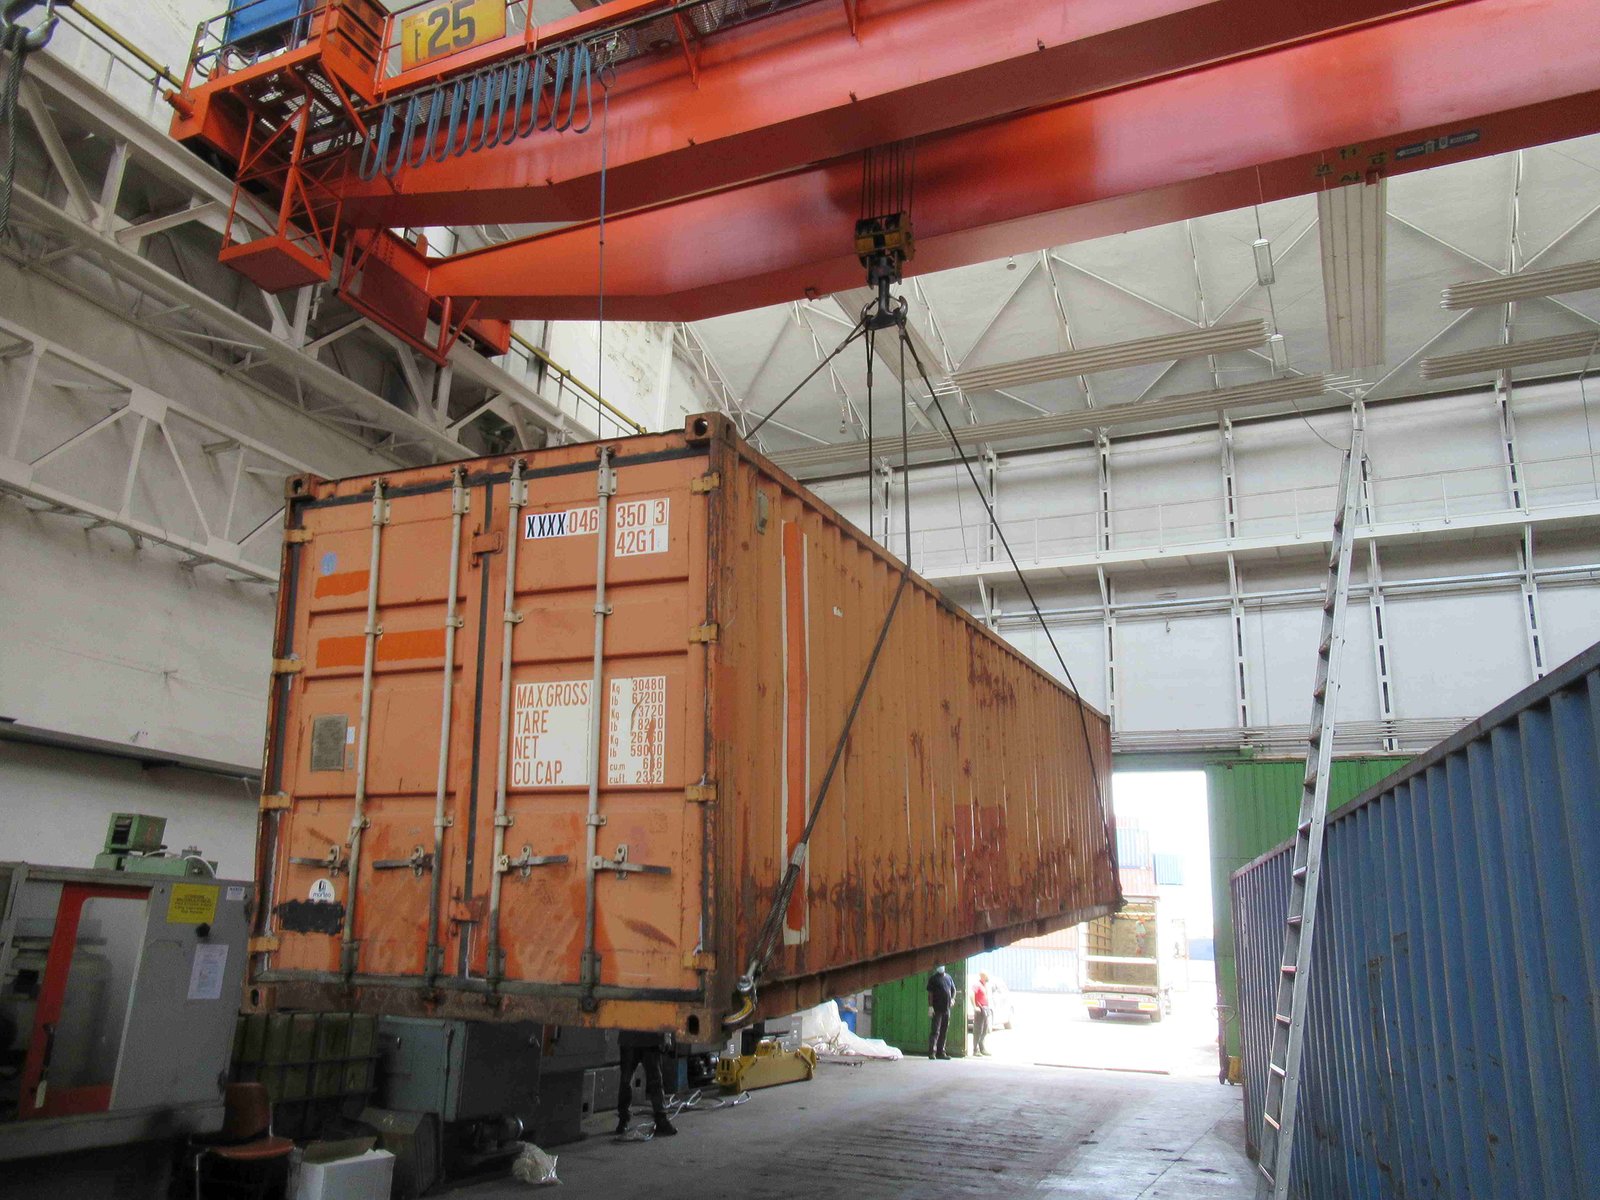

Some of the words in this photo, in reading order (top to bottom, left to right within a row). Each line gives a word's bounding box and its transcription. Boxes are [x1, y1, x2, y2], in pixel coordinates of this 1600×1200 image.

[428, 0, 475, 58] 25
[617, 503, 647, 529] 350
[655, 501, 665, 524] 3
[616, 528, 655, 554] 42G1
[632, 678, 664, 691] 30480
[632, 691, 664, 704] 67200
[516, 710, 549, 734] TARE
[638, 704, 664, 717] 3720
[514, 736, 539, 759] NET
